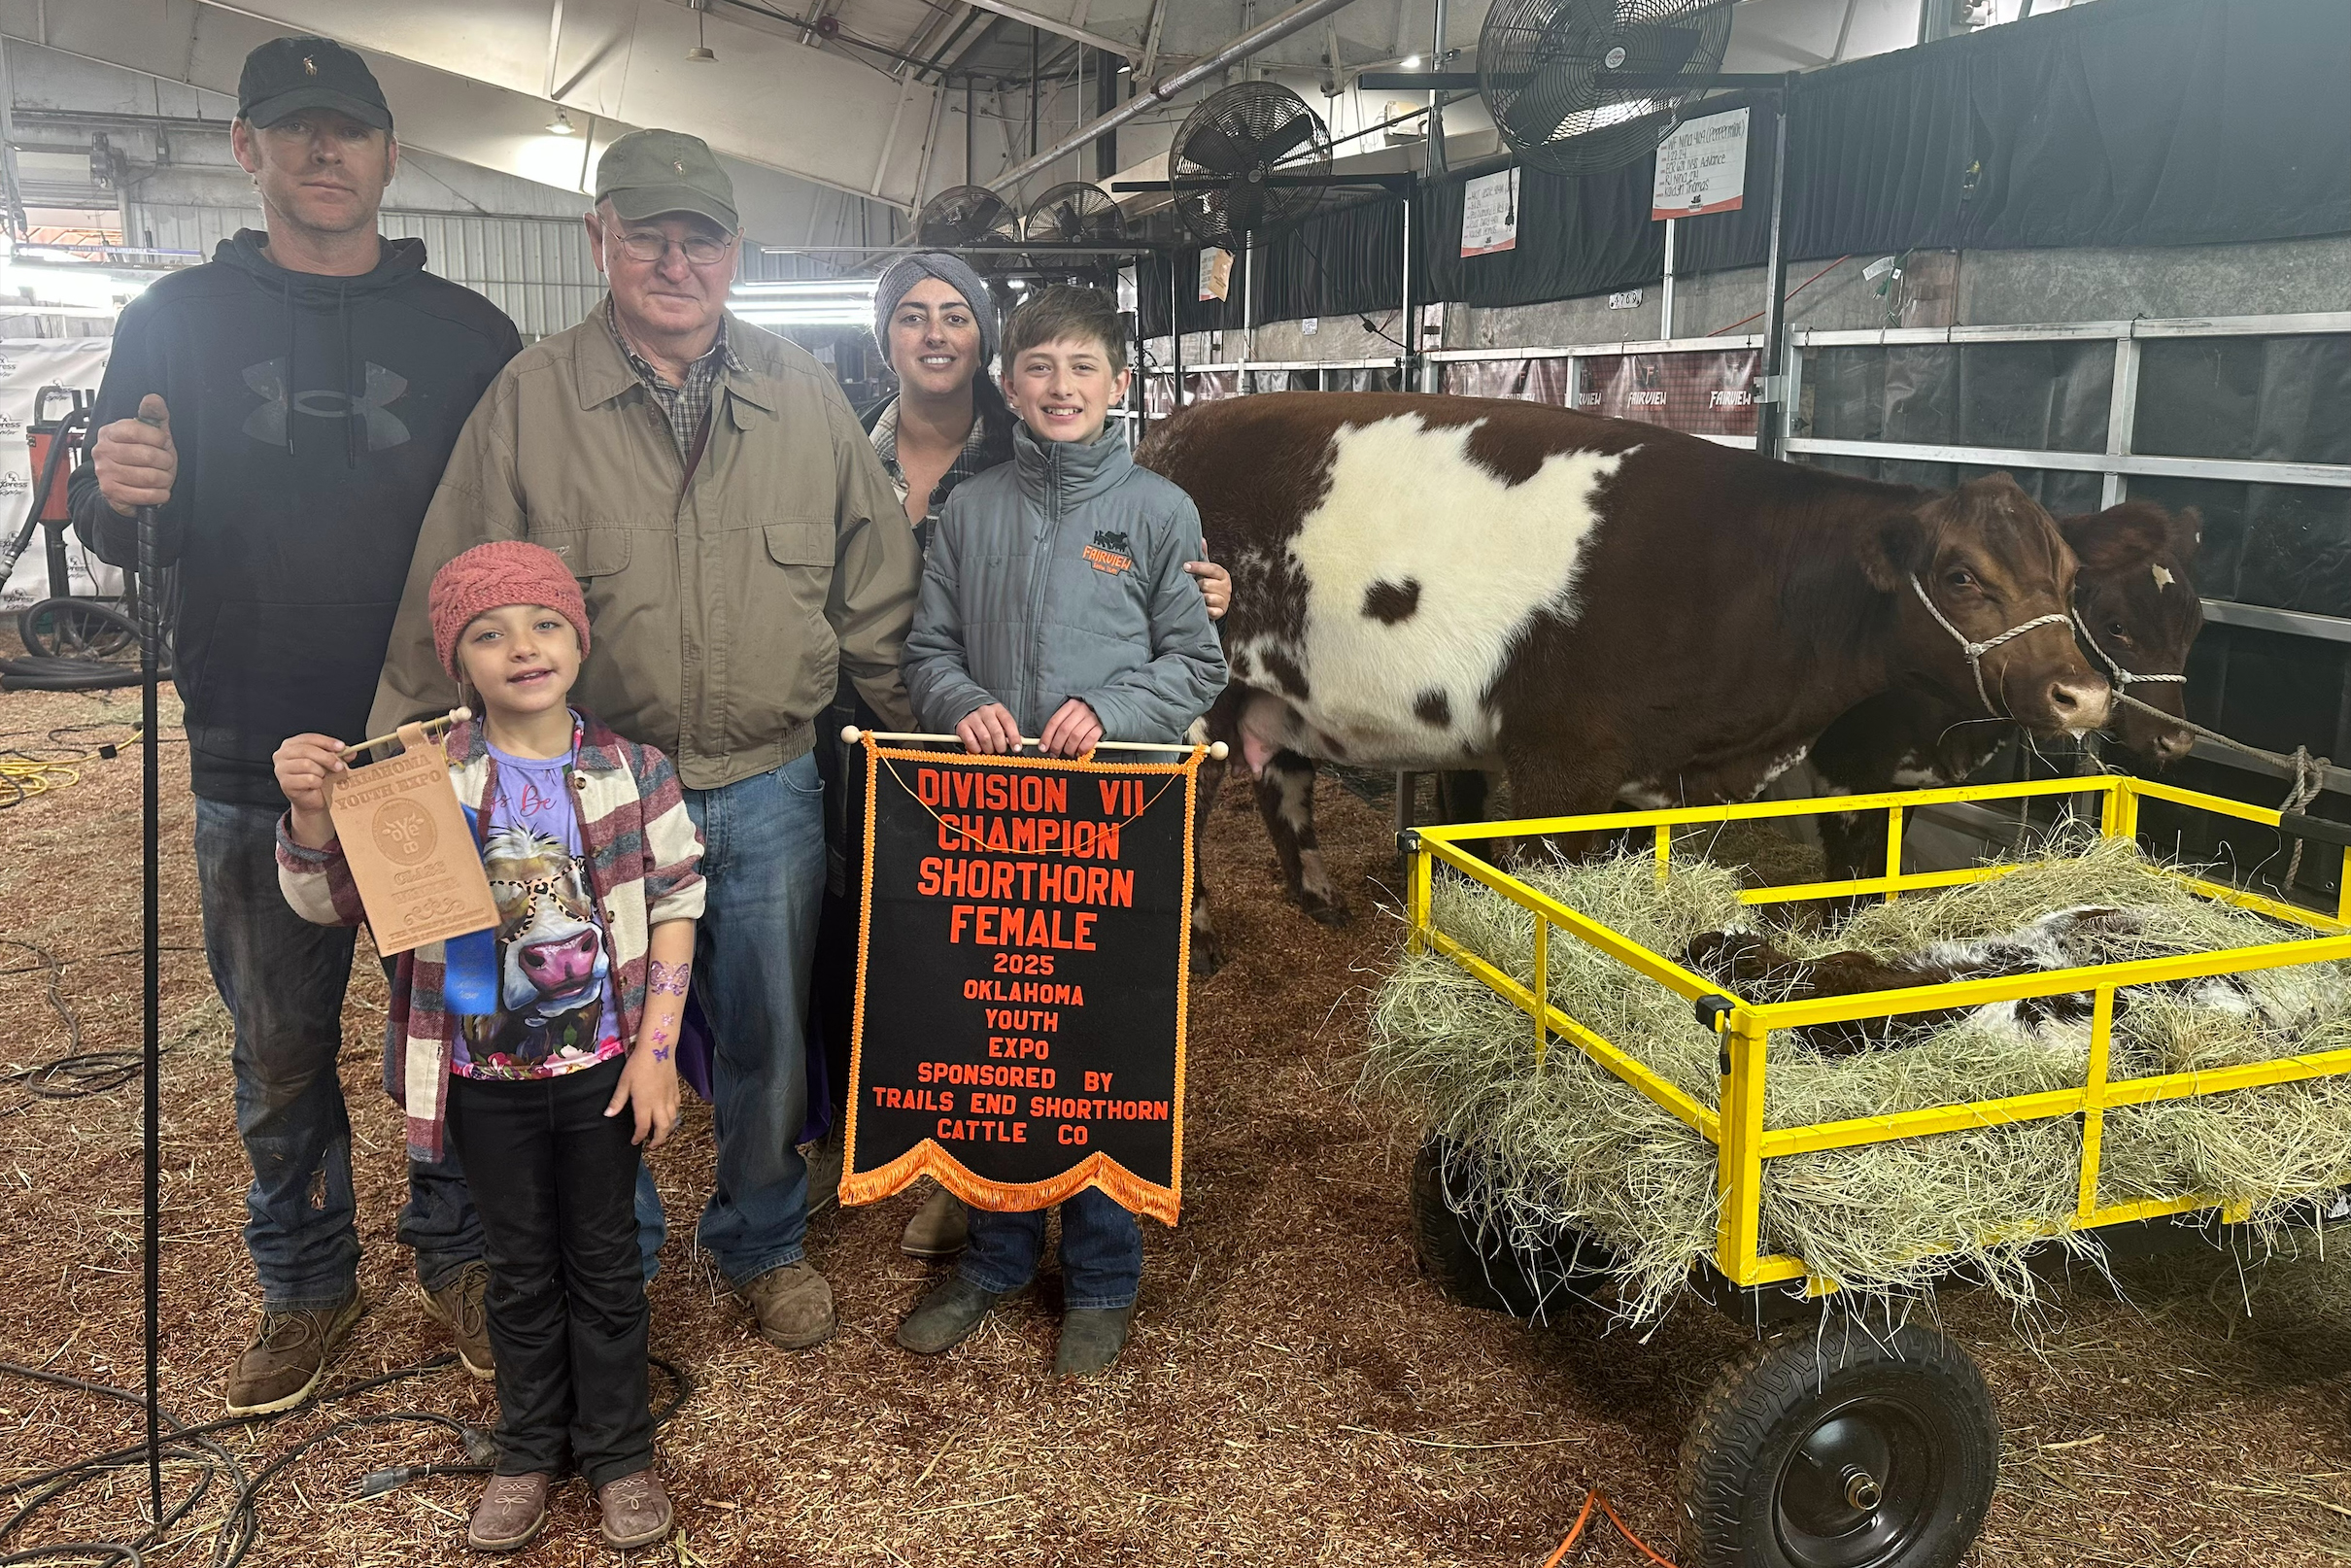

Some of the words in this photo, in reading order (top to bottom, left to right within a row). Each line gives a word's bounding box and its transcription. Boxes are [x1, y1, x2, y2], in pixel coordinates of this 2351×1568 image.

[1627, 391, 1667, 409] FAIRVIEW
[1709, 390, 1752, 410] FAIRVIEW
[1082, 545, 1133, 571] FAIRVIEW
[336, 754, 431, 791] OKLAHOMA
[334, 783, 396, 810] YOUTH
[396, 770, 442, 793] EXPO
[520, 783, 557, 817] Be
[918, 768, 1067, 813] DIVISION
[1099, 780, 1144, 816] VII
[938, 814, 1120, 860] CHAMPION
[917, 858, 1134, 907] SHORTHORN
[950, 905, 1097, 951] FEMALE
[993, 953, 1054, 975] 2025
[963, 979, 1084, 1006] OKLAHOMA
[985, 1009, 1058, 1033] YOUTH
[988, 1037, 1049, 1060] EXPO
[918, 1062, 1056, 1089] SPONSORED
[1084, 1071, 1113, 1092] BY
[872, 1087, 953, 1111] TRAILS
[970, 1093, 1016, 1115] END
[1030, 1097, 1169, 1120] SHORTHORN
[937, 1118, 1027, 1142] CATTLE
[1057, 1124, 1088, 1144] CO
